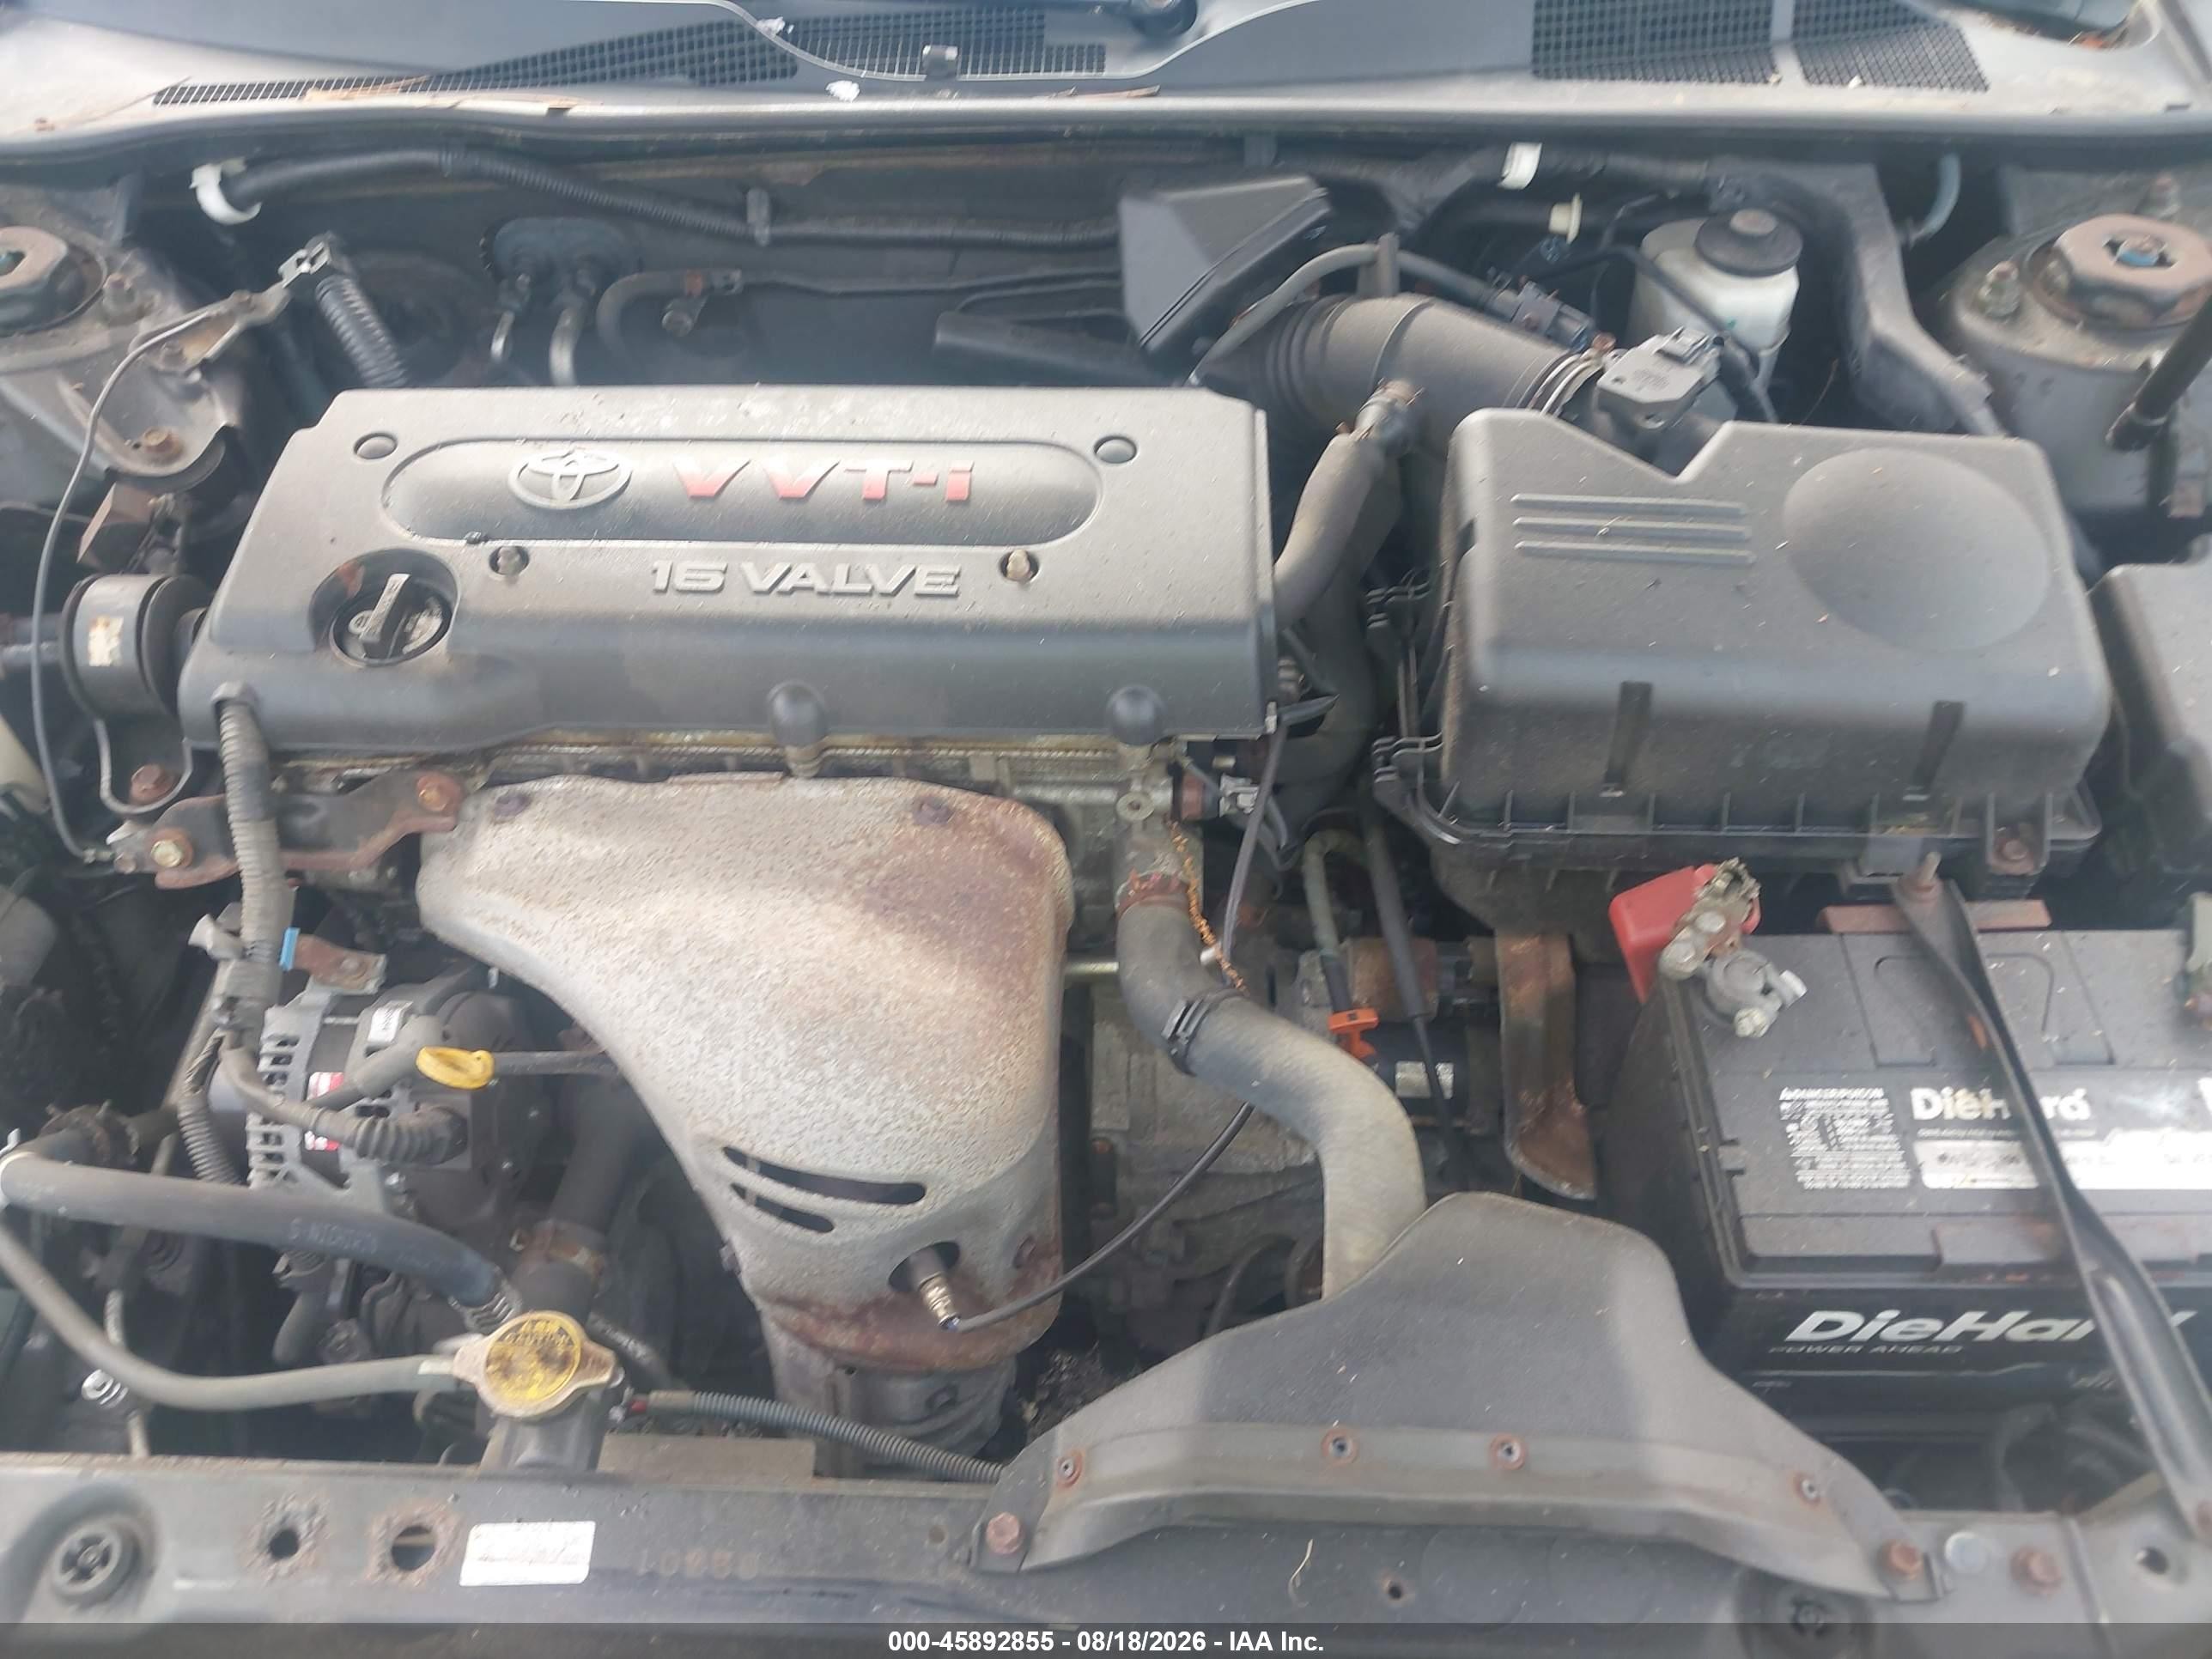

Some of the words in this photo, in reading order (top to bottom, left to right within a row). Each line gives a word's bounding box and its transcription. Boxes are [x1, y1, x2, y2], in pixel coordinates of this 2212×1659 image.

[652, 561, 728, 592] 16
[740, 562, 961, 597] VALVE
[1911, 1086, 2092, 1120] DieHrd
[1869, 1346, 1964, 1354] AHEAD
